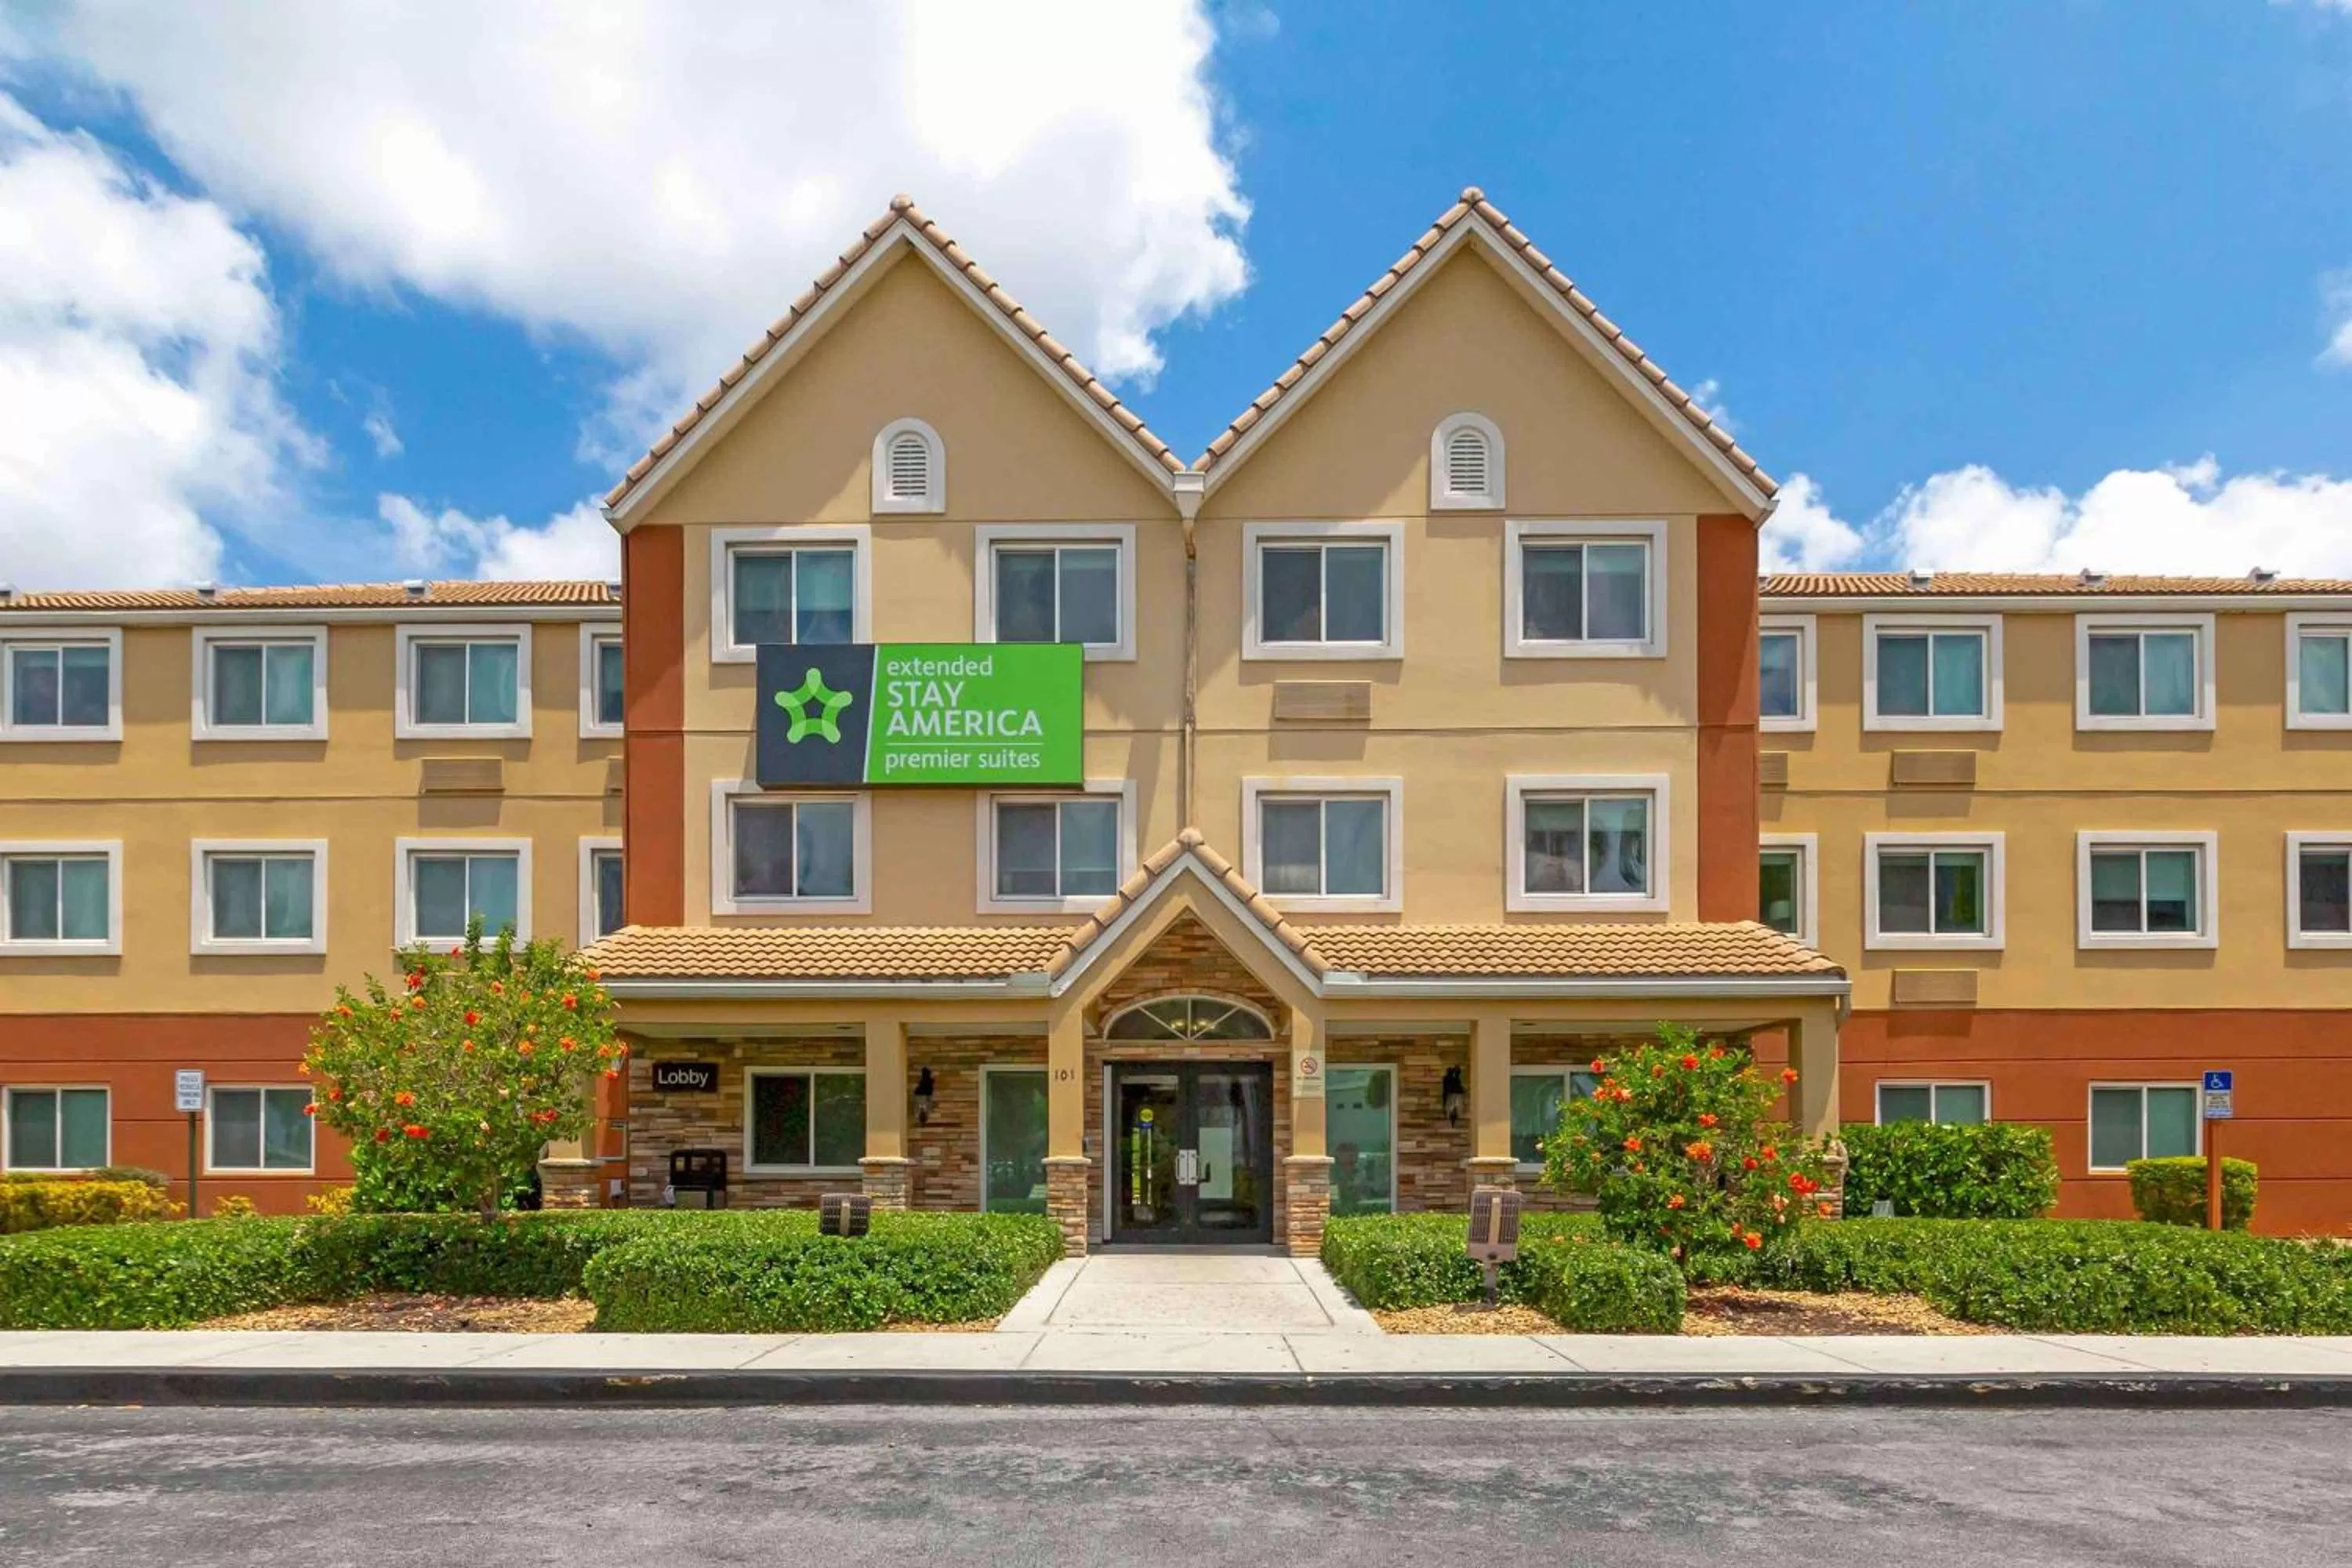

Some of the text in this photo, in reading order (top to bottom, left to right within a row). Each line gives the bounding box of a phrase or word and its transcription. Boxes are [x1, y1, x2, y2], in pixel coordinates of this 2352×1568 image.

[887, 655, 993, 676] extended
[887, 681, 964, 707] STAY
[887, 710, 1042, 736] AMERICA
[885, 749, 1040, 775] premier suites
[659, 1068, 709, 1087] Lobby
[1054, 1069, 1075, 1081] 101
